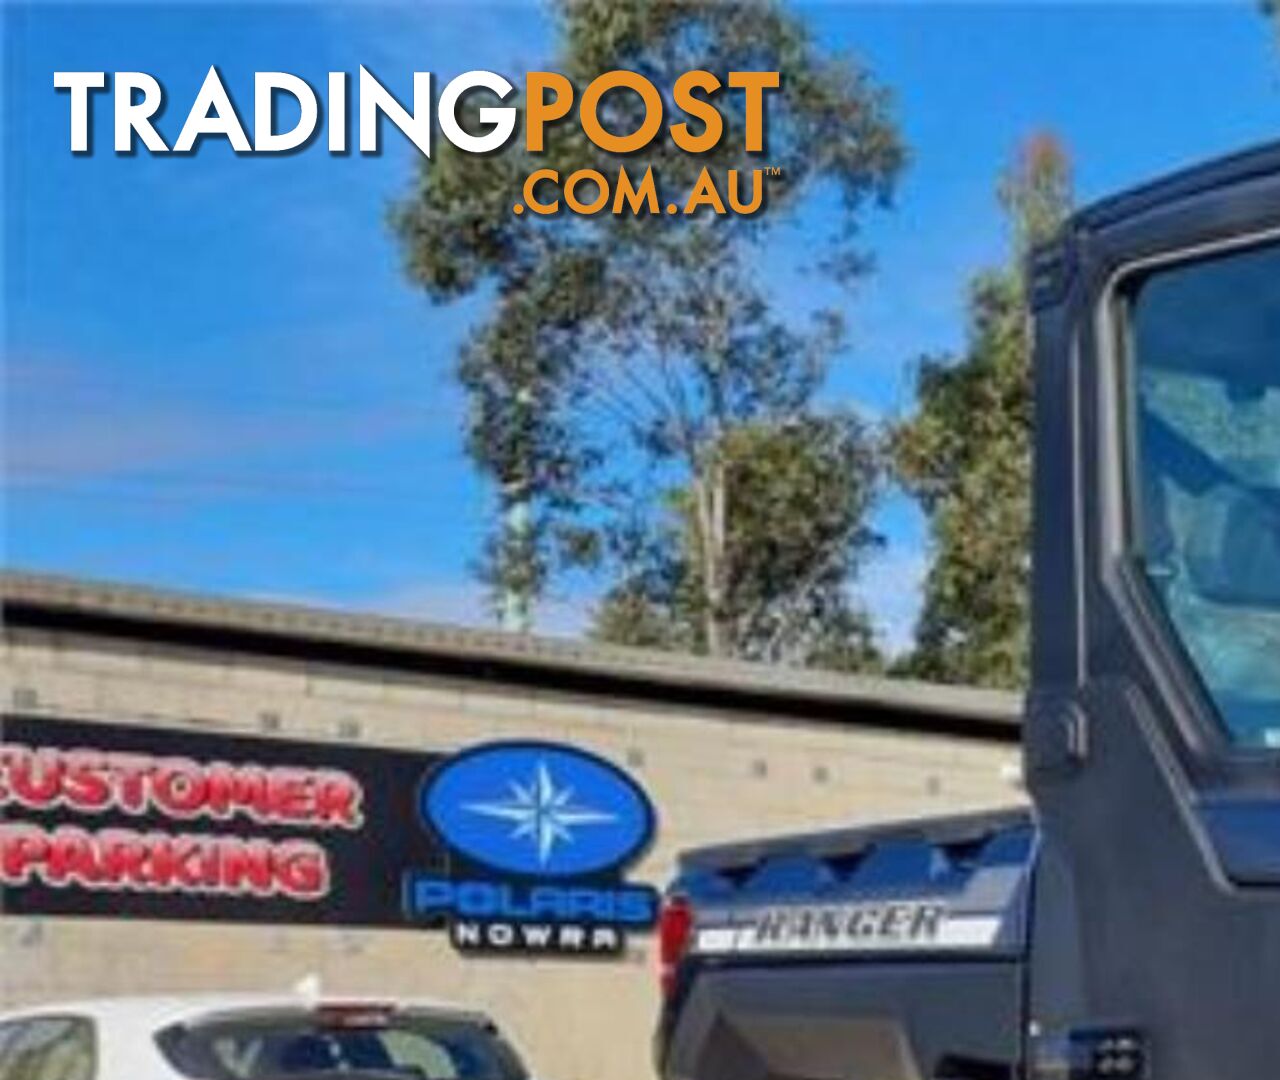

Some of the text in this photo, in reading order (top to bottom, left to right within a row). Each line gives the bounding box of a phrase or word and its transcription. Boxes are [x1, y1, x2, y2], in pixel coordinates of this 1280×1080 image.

[0, 744, 358, 829] USTOMER
[0, 823, 330, 899] PARKING
[412, 879, 652, 923] POLARIS
[752, 901, 944, 944] RANGER
[456, 922, 618, 948] NOWRA
